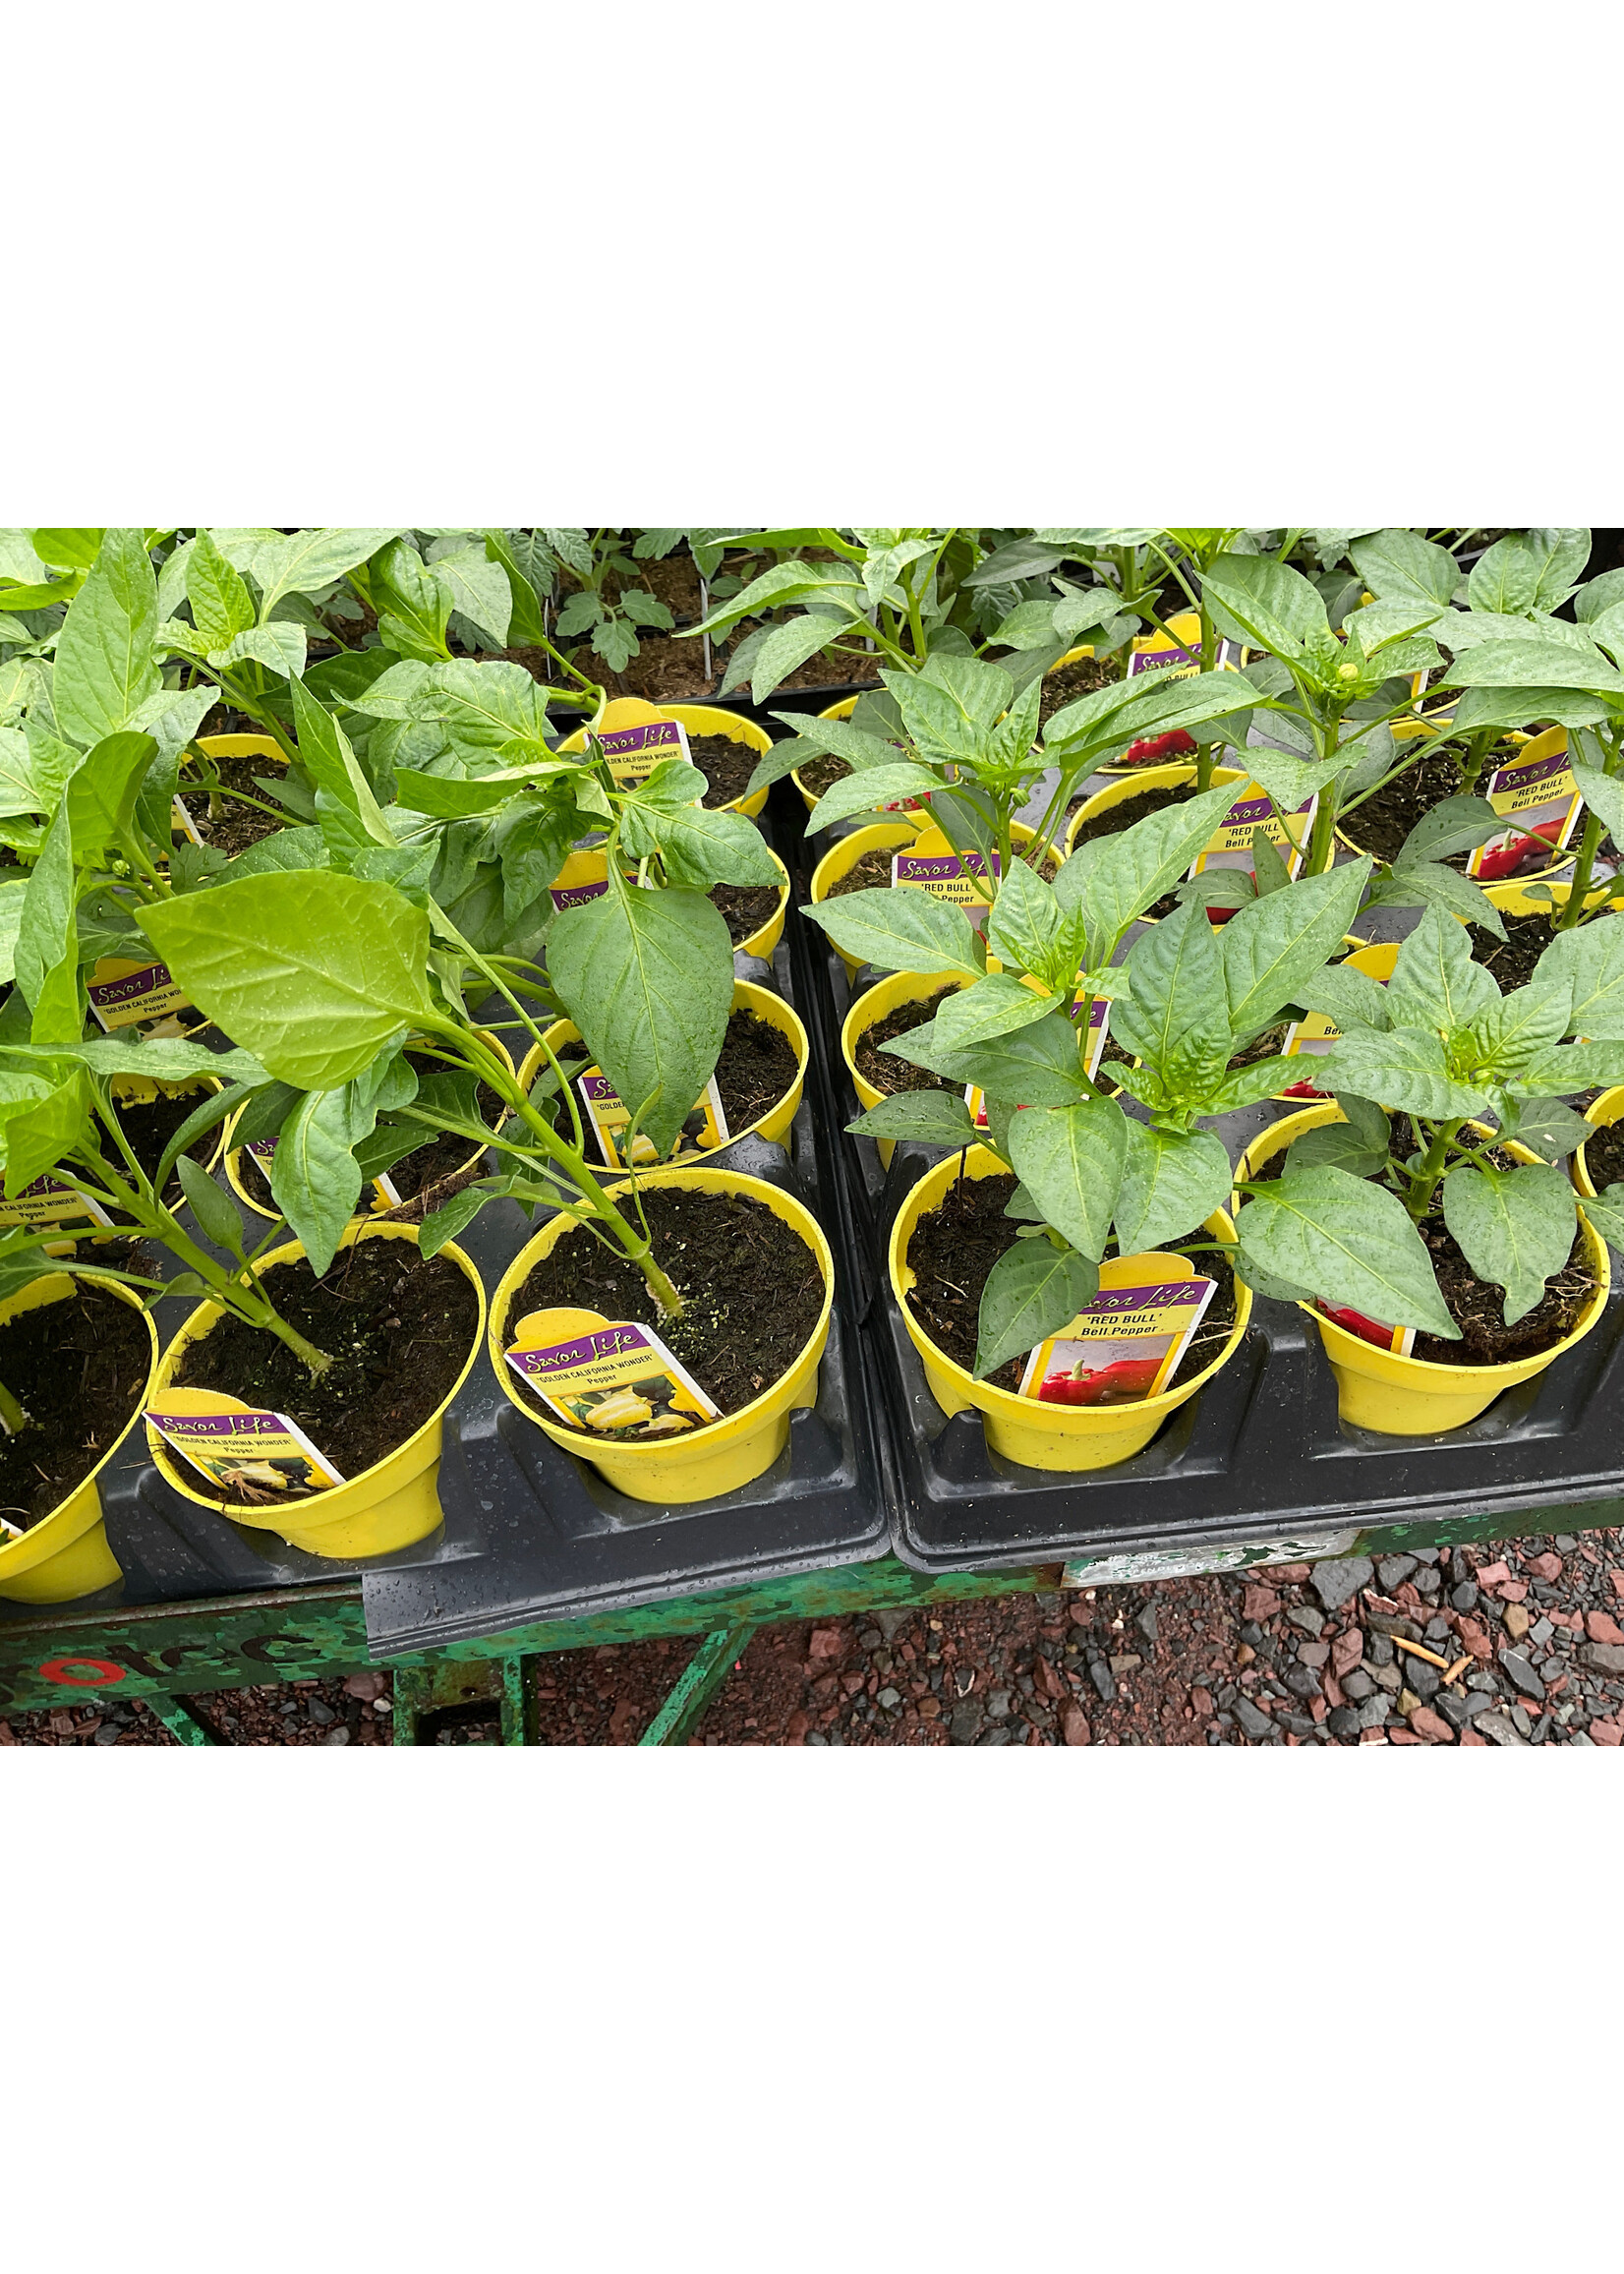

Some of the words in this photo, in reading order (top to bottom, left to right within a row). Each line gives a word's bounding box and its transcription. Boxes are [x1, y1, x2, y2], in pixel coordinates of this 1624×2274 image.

[643, 726, 675, 750] Life
[622, 754, 655, 764] CALIFORNIA
[1497, 765, 1550, 791] Savor
[1515, 786, 1537, 797] 'RED
[1539, 776, 1568, 790] BULL'
[1511, 797, 1530, 809] Bell
[1532, 787, 1564, 803] Pepper
[1224, 806, 1265, 822] avor
[1229, 827, 1251, 837] 'RED
[1260, 824, 1279, 833] ULL
[1225, 839, 1244, 848] Bell
[1247, 835, 1280, 845] Per
[901, 860, 953, 880] Savor
[921, 883, 944, 892] 'RED
[98, 980, 146, 1005] Savor
[152, 967, 171, 991] Li
[132, 993, 168, 1008] CALIFORNIA
[143, 1003, 167, 1014] Pepper
[597, 1101, 625, 1111] 'GOLDE
[4, 1201, 44, 1211] CALIFORNIA
[19, 1211, 46, 1220] Pepper
[1083, 1296, 1137, 1309] avor
[1137, 1285, 1198, 1311] Life
[1086, 1315, 1119, 1325] 'RED
[1122, 1312, 1163, 1324] BULL'
[1081, 1327, 1108, 1336] Bell
[1111, 1326, 1159, 1336] Pepper
[525, 1350, 586, 1373] Savor
[590, 1331, 639, 1361] Life
[536, 1372, 573, 1383] 'GOLDEN
[572, 1365, 617, 1378] CALIFORNIA
[617, 1354, 654, 1369] WONDER'
[587, 1374, 617, 1385] Pepper
[162, 1418, 223, 1433] Savor
[228, 1417, 278, 1436] Life
[207, 1438, 255, 1447] CALIFORNIA
[254, 1438, 292, 1447] WONDER'
